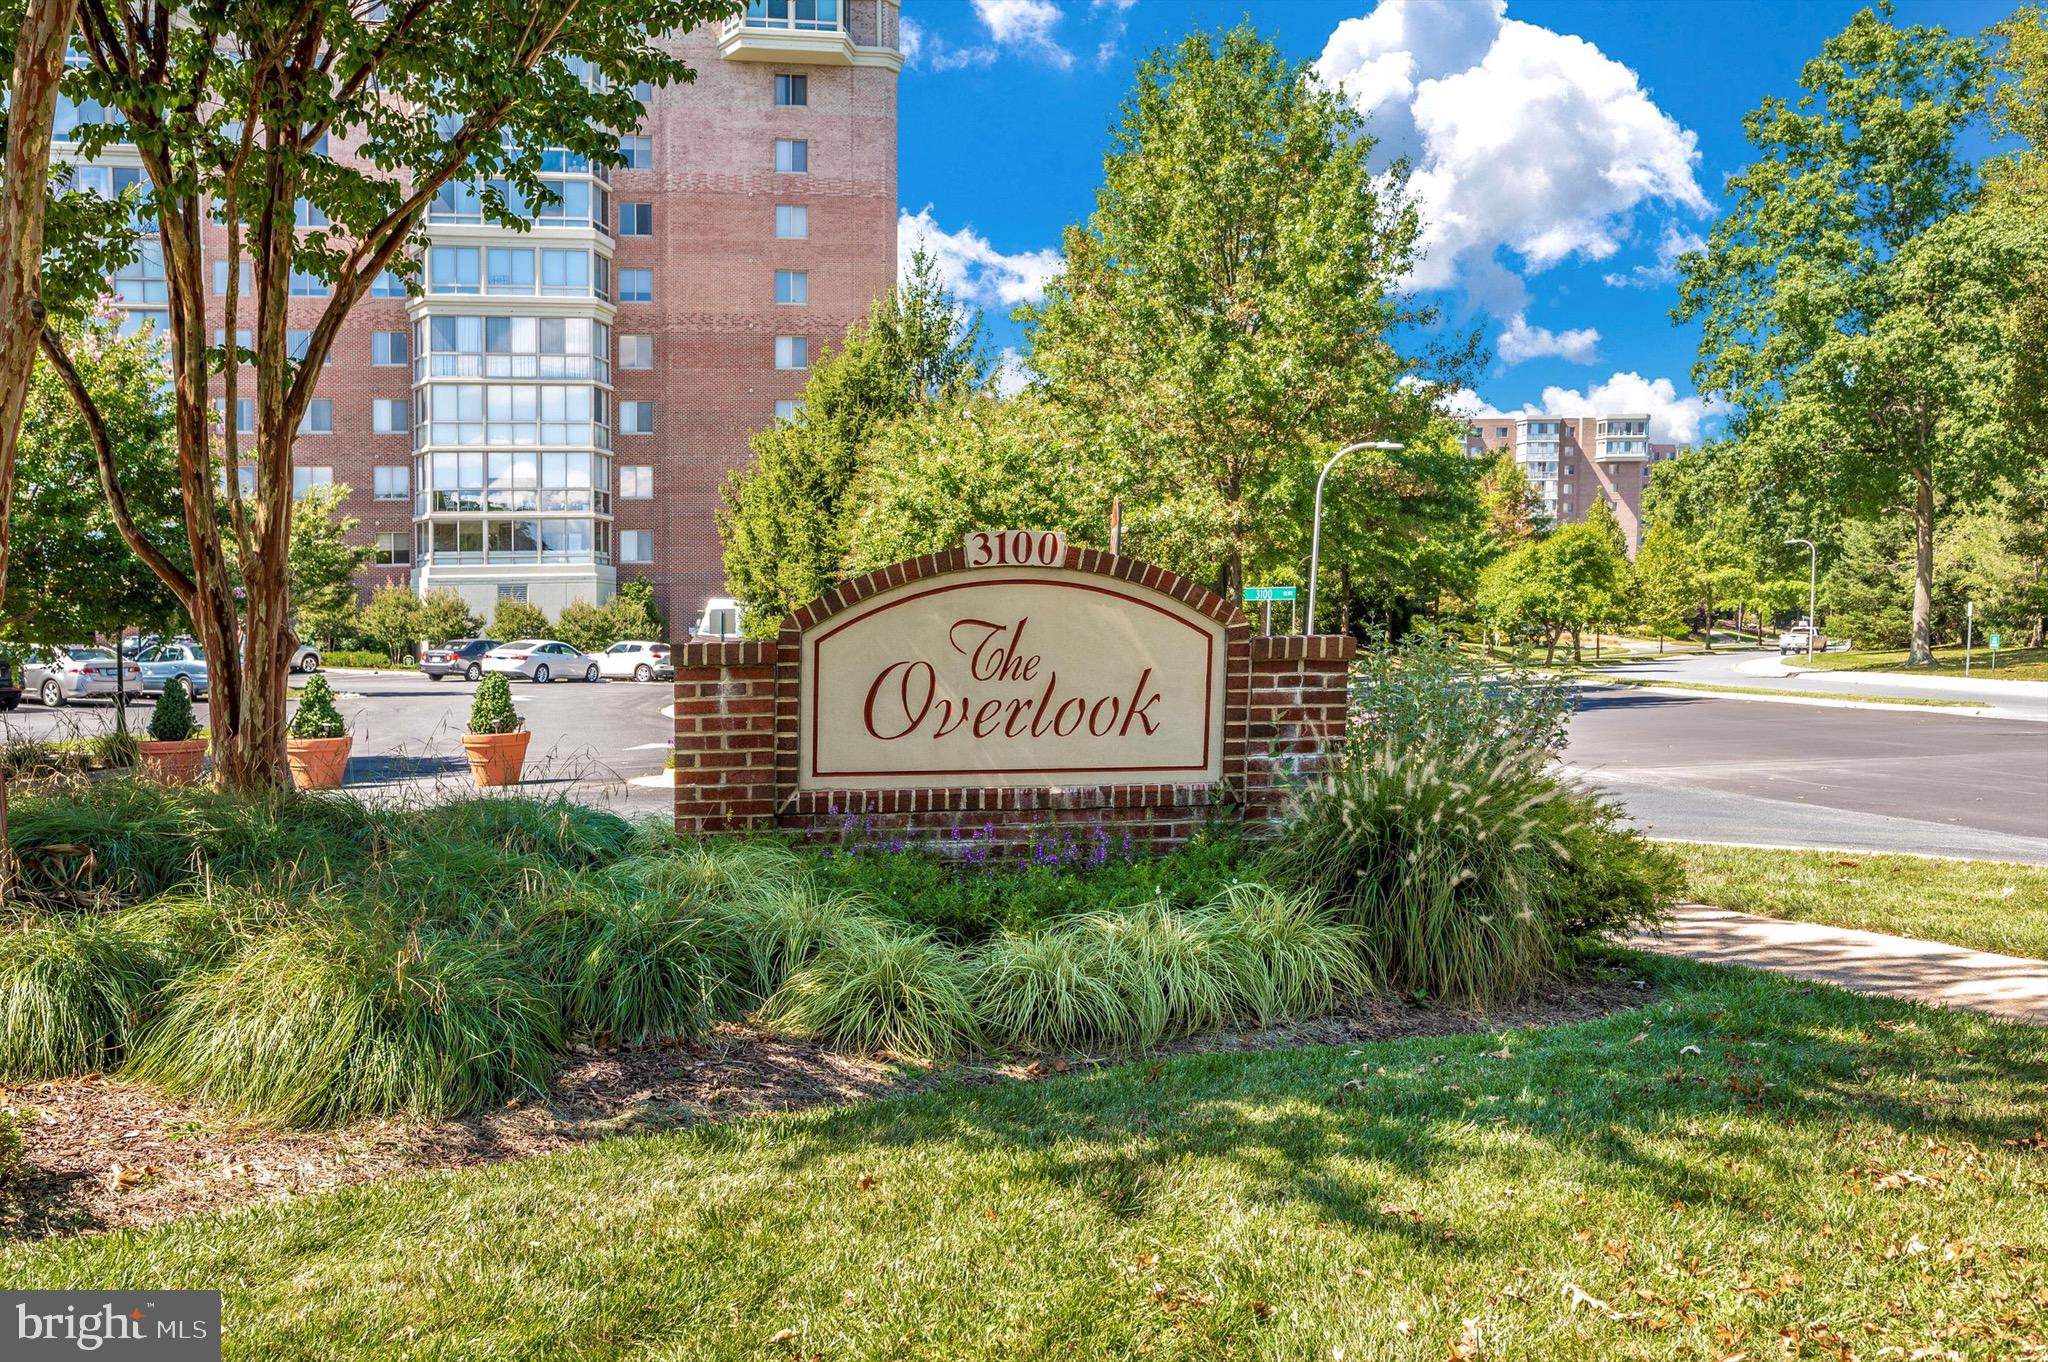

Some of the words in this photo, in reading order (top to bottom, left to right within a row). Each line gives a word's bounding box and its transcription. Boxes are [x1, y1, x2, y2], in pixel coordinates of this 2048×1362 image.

[972, 531, 1059, 566] 3100
[1256, 589, 1273, 599] 3100
[949, 616, 1041, 682] The
[864, 660, 1161, 740] Overlook
